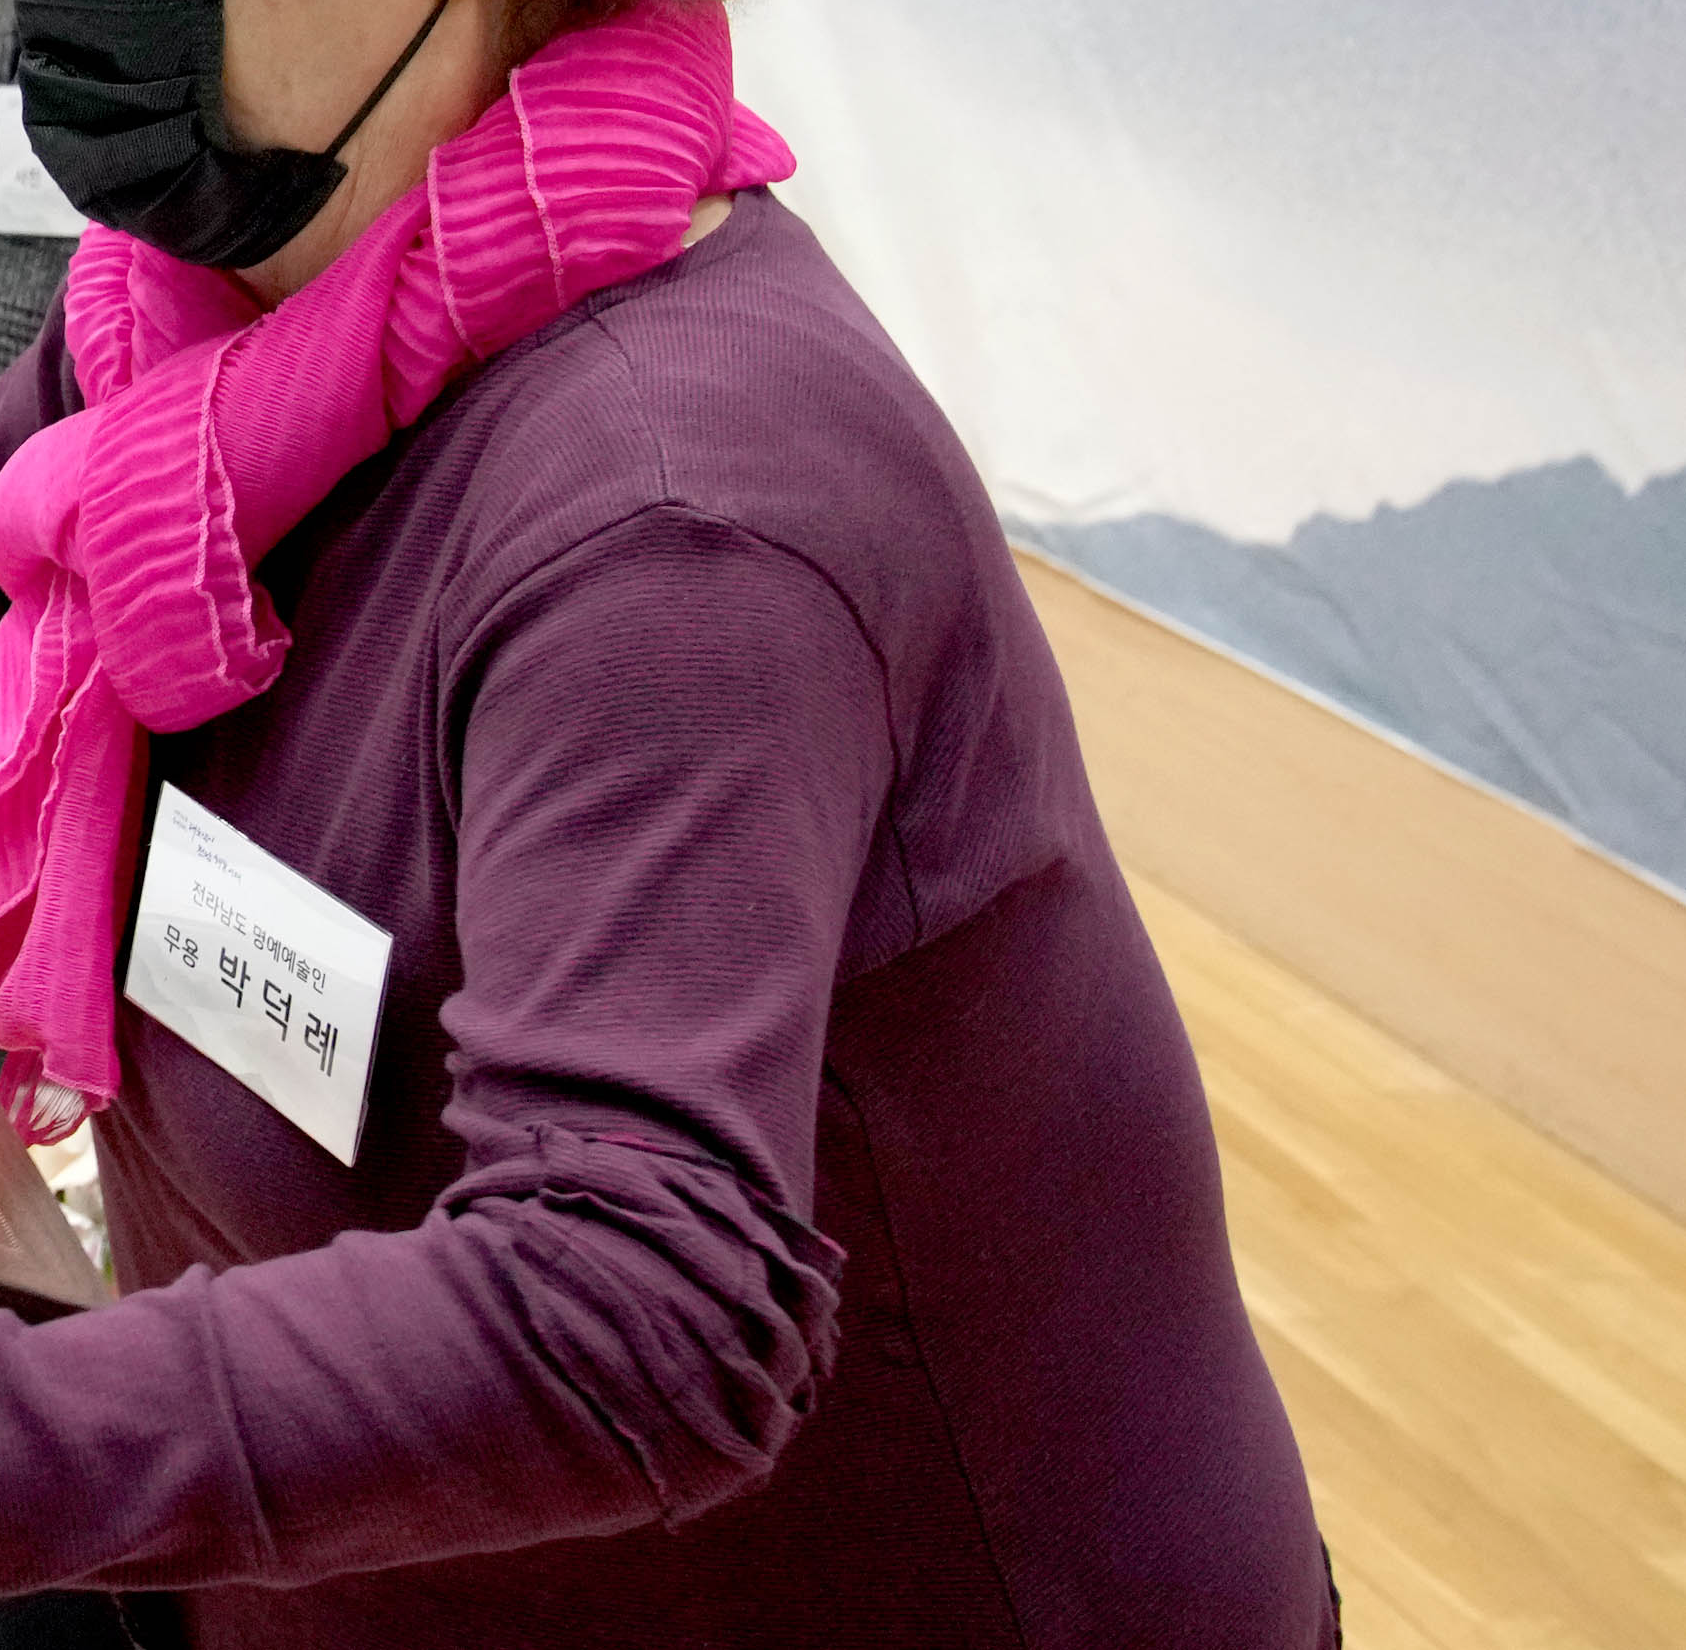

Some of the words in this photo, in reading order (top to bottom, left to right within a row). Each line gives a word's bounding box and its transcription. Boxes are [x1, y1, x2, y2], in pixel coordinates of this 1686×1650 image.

[163, 923, 200, 969] 무용
[191, 879, 248, 936] 전라남도
[252, 925, 327, 996] 명예예술인
